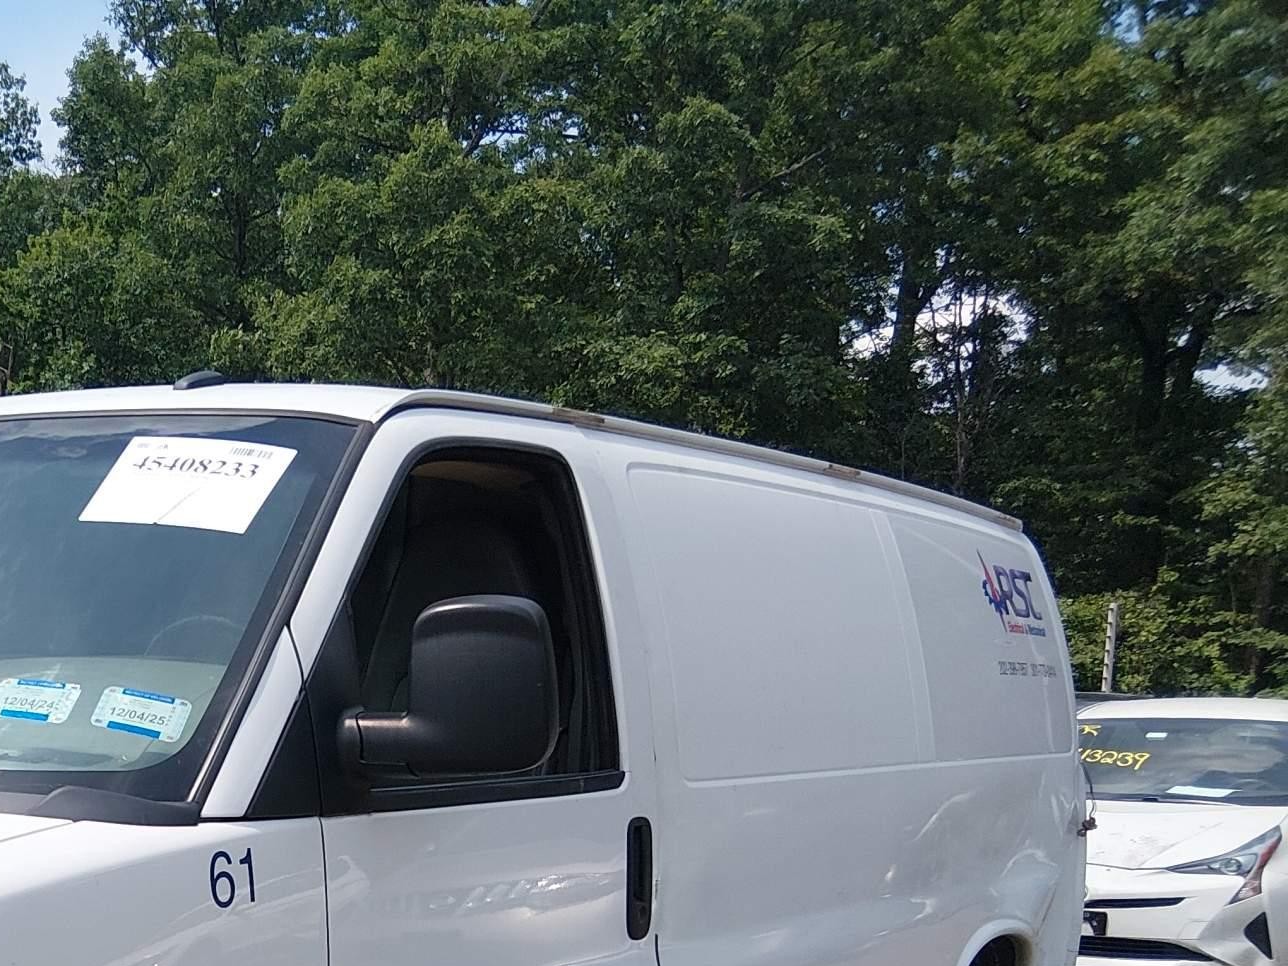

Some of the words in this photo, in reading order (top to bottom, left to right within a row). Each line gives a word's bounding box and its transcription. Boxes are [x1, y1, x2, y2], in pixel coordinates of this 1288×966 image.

[133, 455, 260, 479] 45408233
[110, 706, 165, 725] 12/04/25
[210, 848, 255, 908] 61
